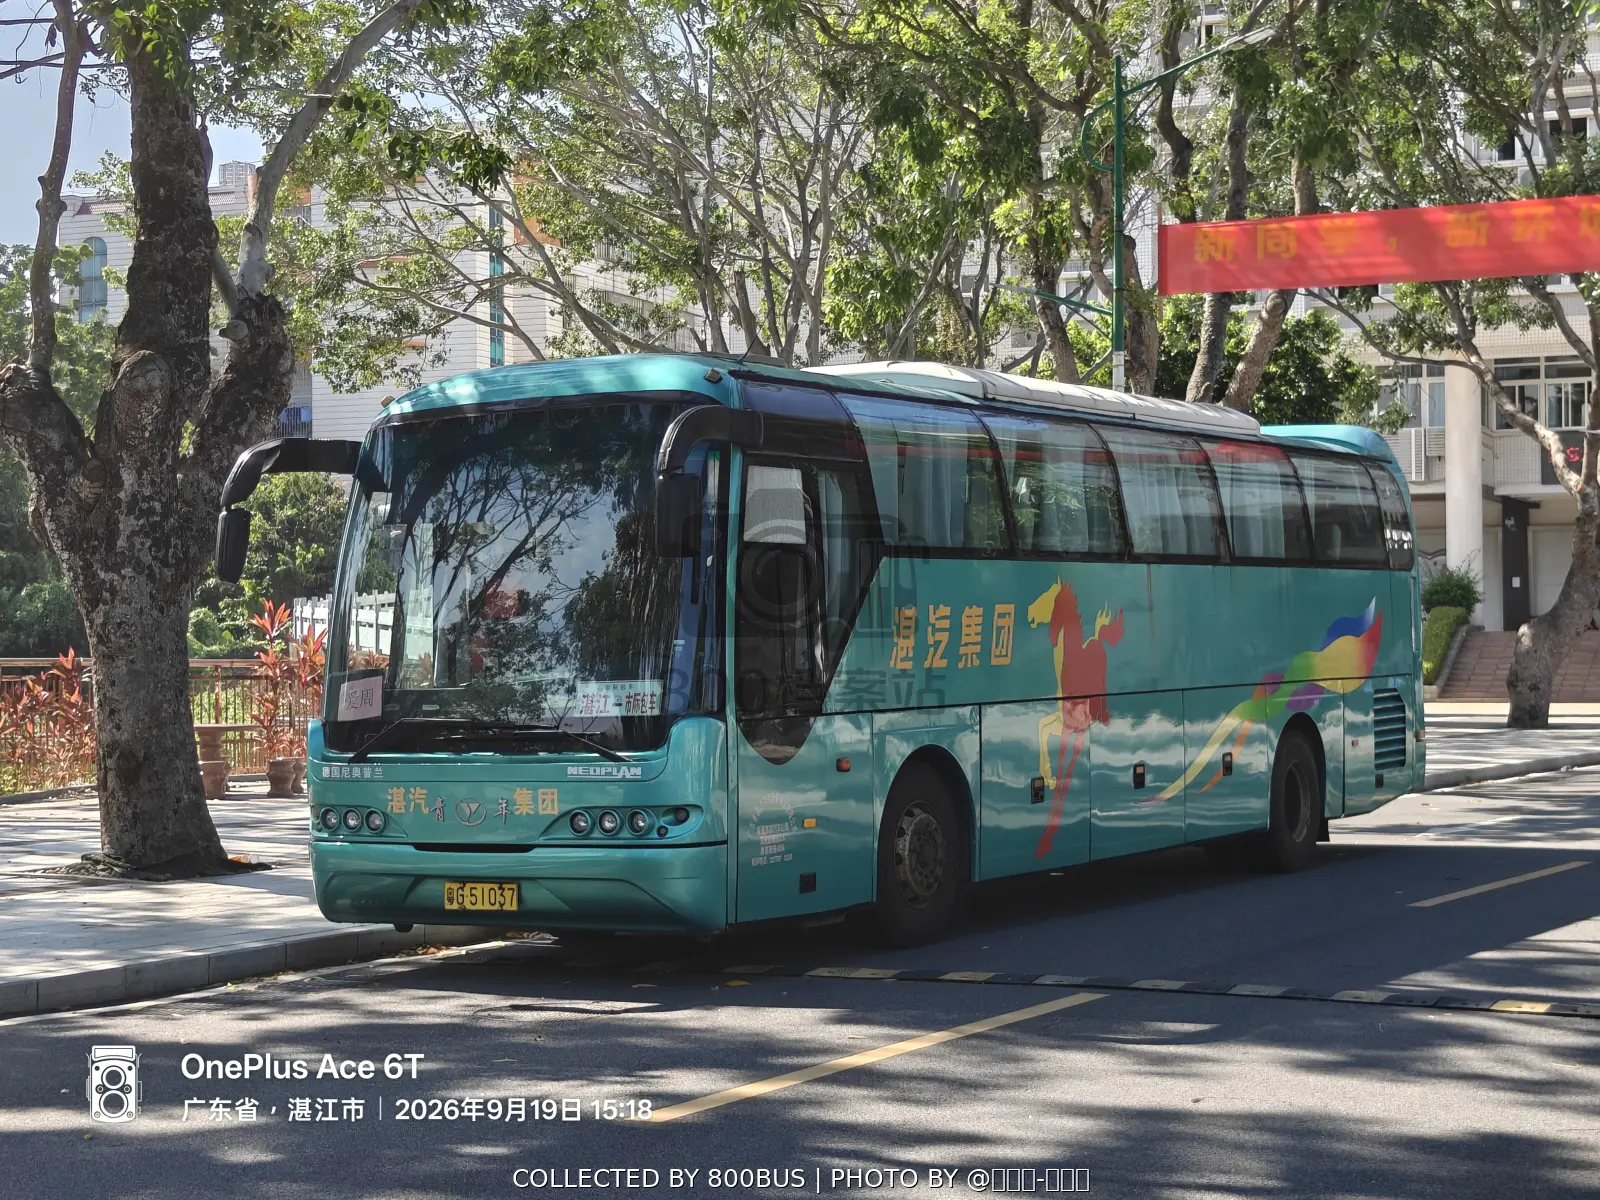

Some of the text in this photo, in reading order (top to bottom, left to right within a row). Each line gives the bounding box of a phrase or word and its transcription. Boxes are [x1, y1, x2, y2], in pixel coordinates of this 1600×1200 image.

[890, 604, 1015, 669] 湛汽集团
[321, 766, 384, 778] 德国尼奥普兰
[566, 765, 642, 779] NEOPLAN
